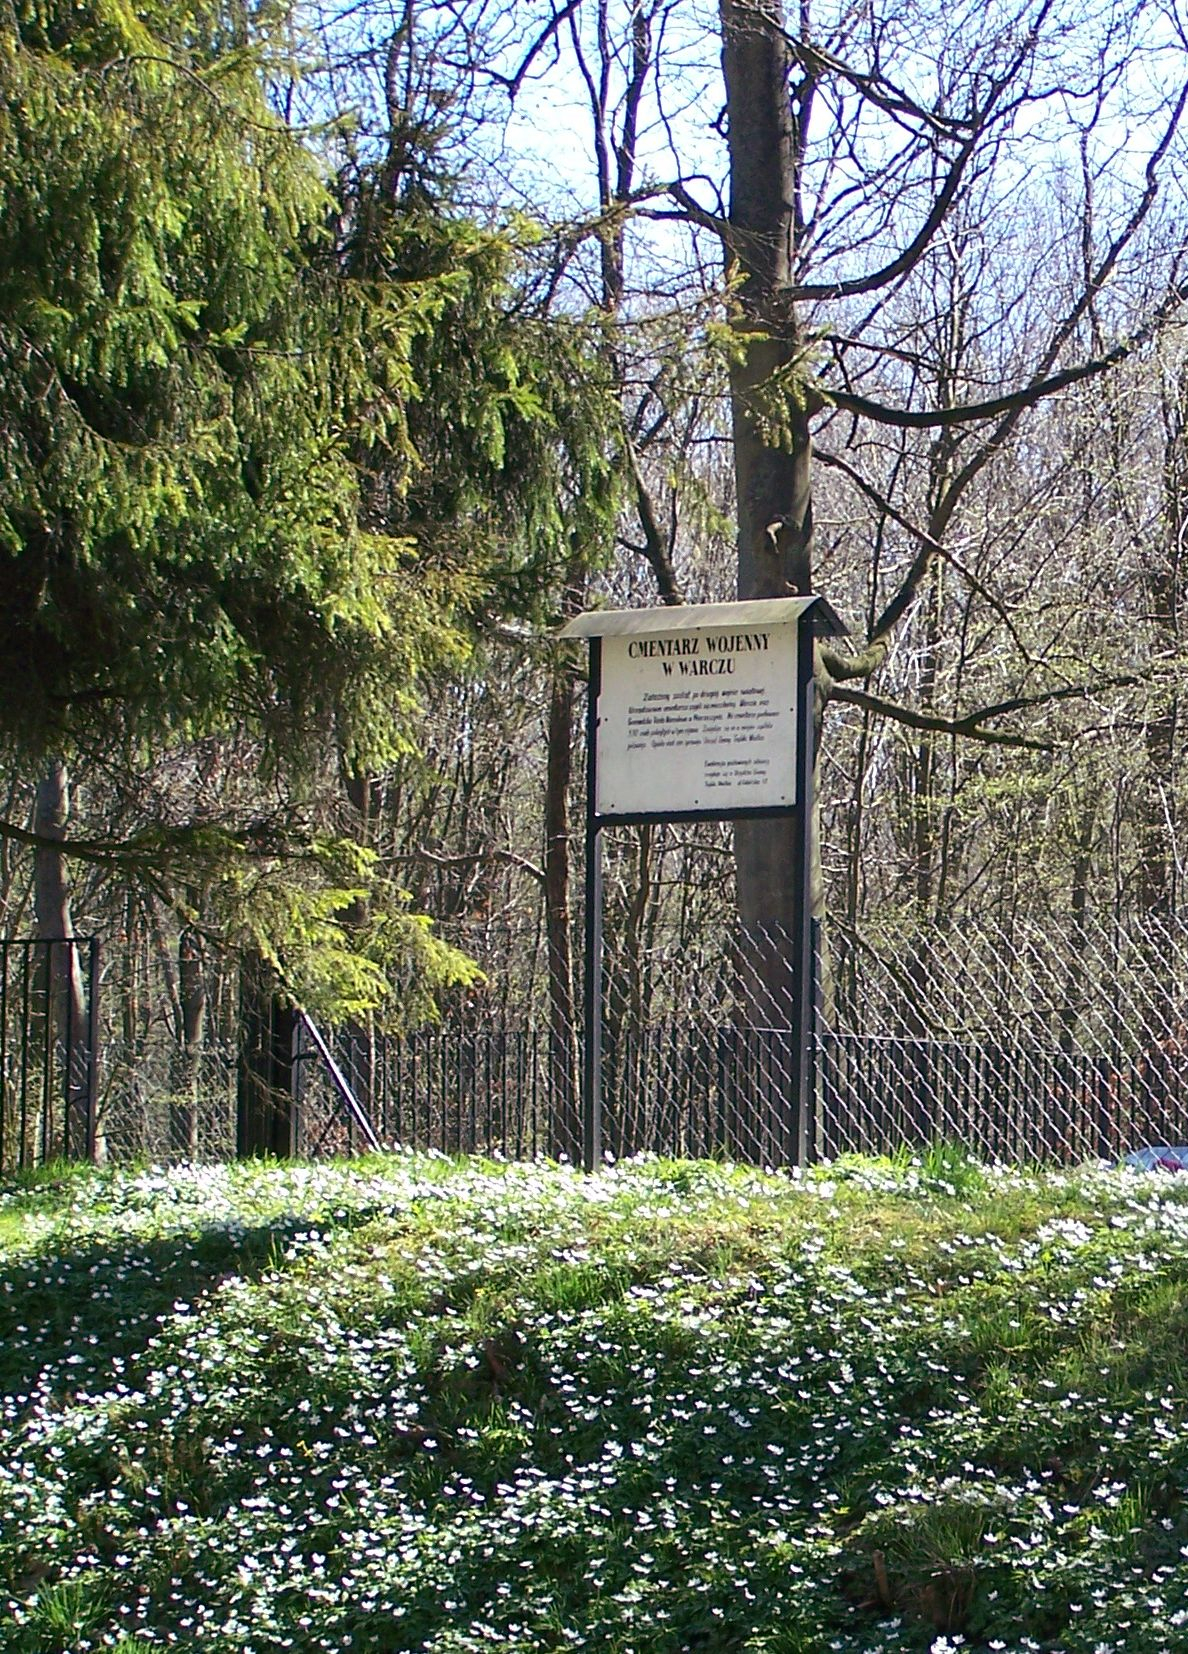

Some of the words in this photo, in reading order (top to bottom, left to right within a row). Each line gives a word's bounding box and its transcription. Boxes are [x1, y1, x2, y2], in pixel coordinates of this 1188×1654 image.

[628, 638, 699, 659] CMENTARZ
[706, 633, 771, 653] WOJENNY
[662, 661, 674, 677] W
[679, 658, 735, 677] WARCZU
